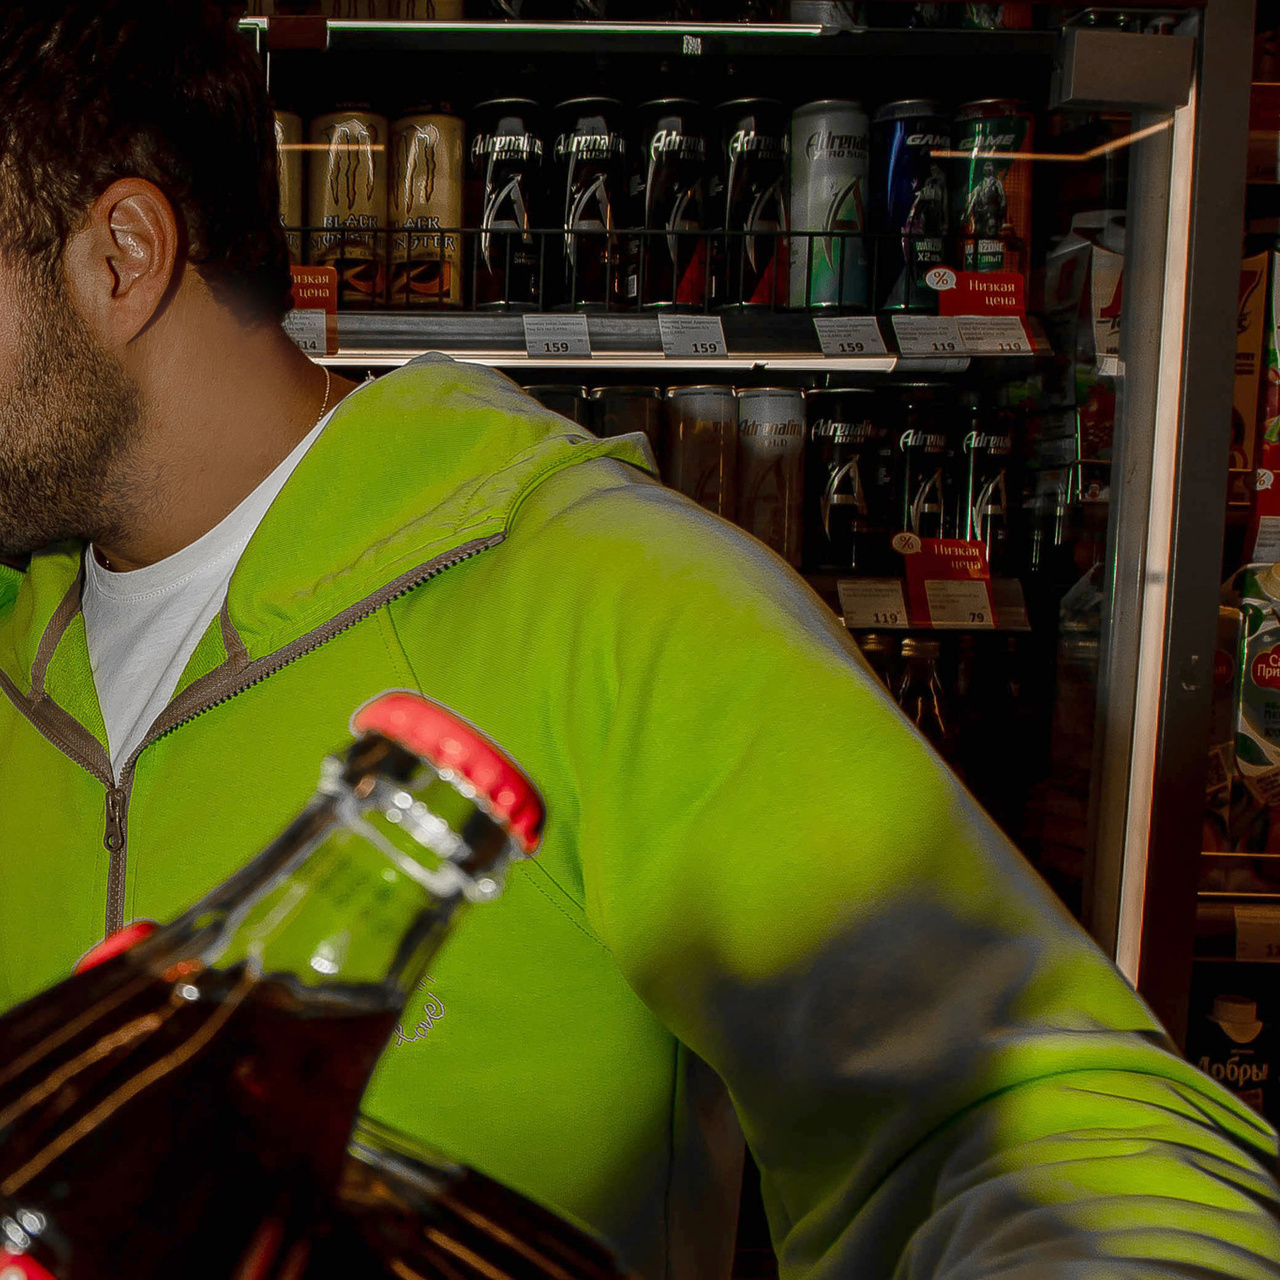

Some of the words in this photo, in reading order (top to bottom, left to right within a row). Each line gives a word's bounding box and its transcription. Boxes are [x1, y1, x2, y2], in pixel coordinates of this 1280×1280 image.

[322, 214, 379, 229] BLACK
[393, 216, 440, 229] ACK
[291, 274, 330, 284] изкая
[969, 279, 1015, 293] Низкая
[299, 287, 330, 299] цена
[984, 295, 1016, 307] цена
[543, 342, 569, 353] 159
[691, 342, 717, 354] 159
[839, 342, 865, 353] 159
[932, 342, 956, 352] 119
[934, 543, 980, 557] Низкая
[873, 612, 898, 624] 119
[969, 612, 985, 623] 79
